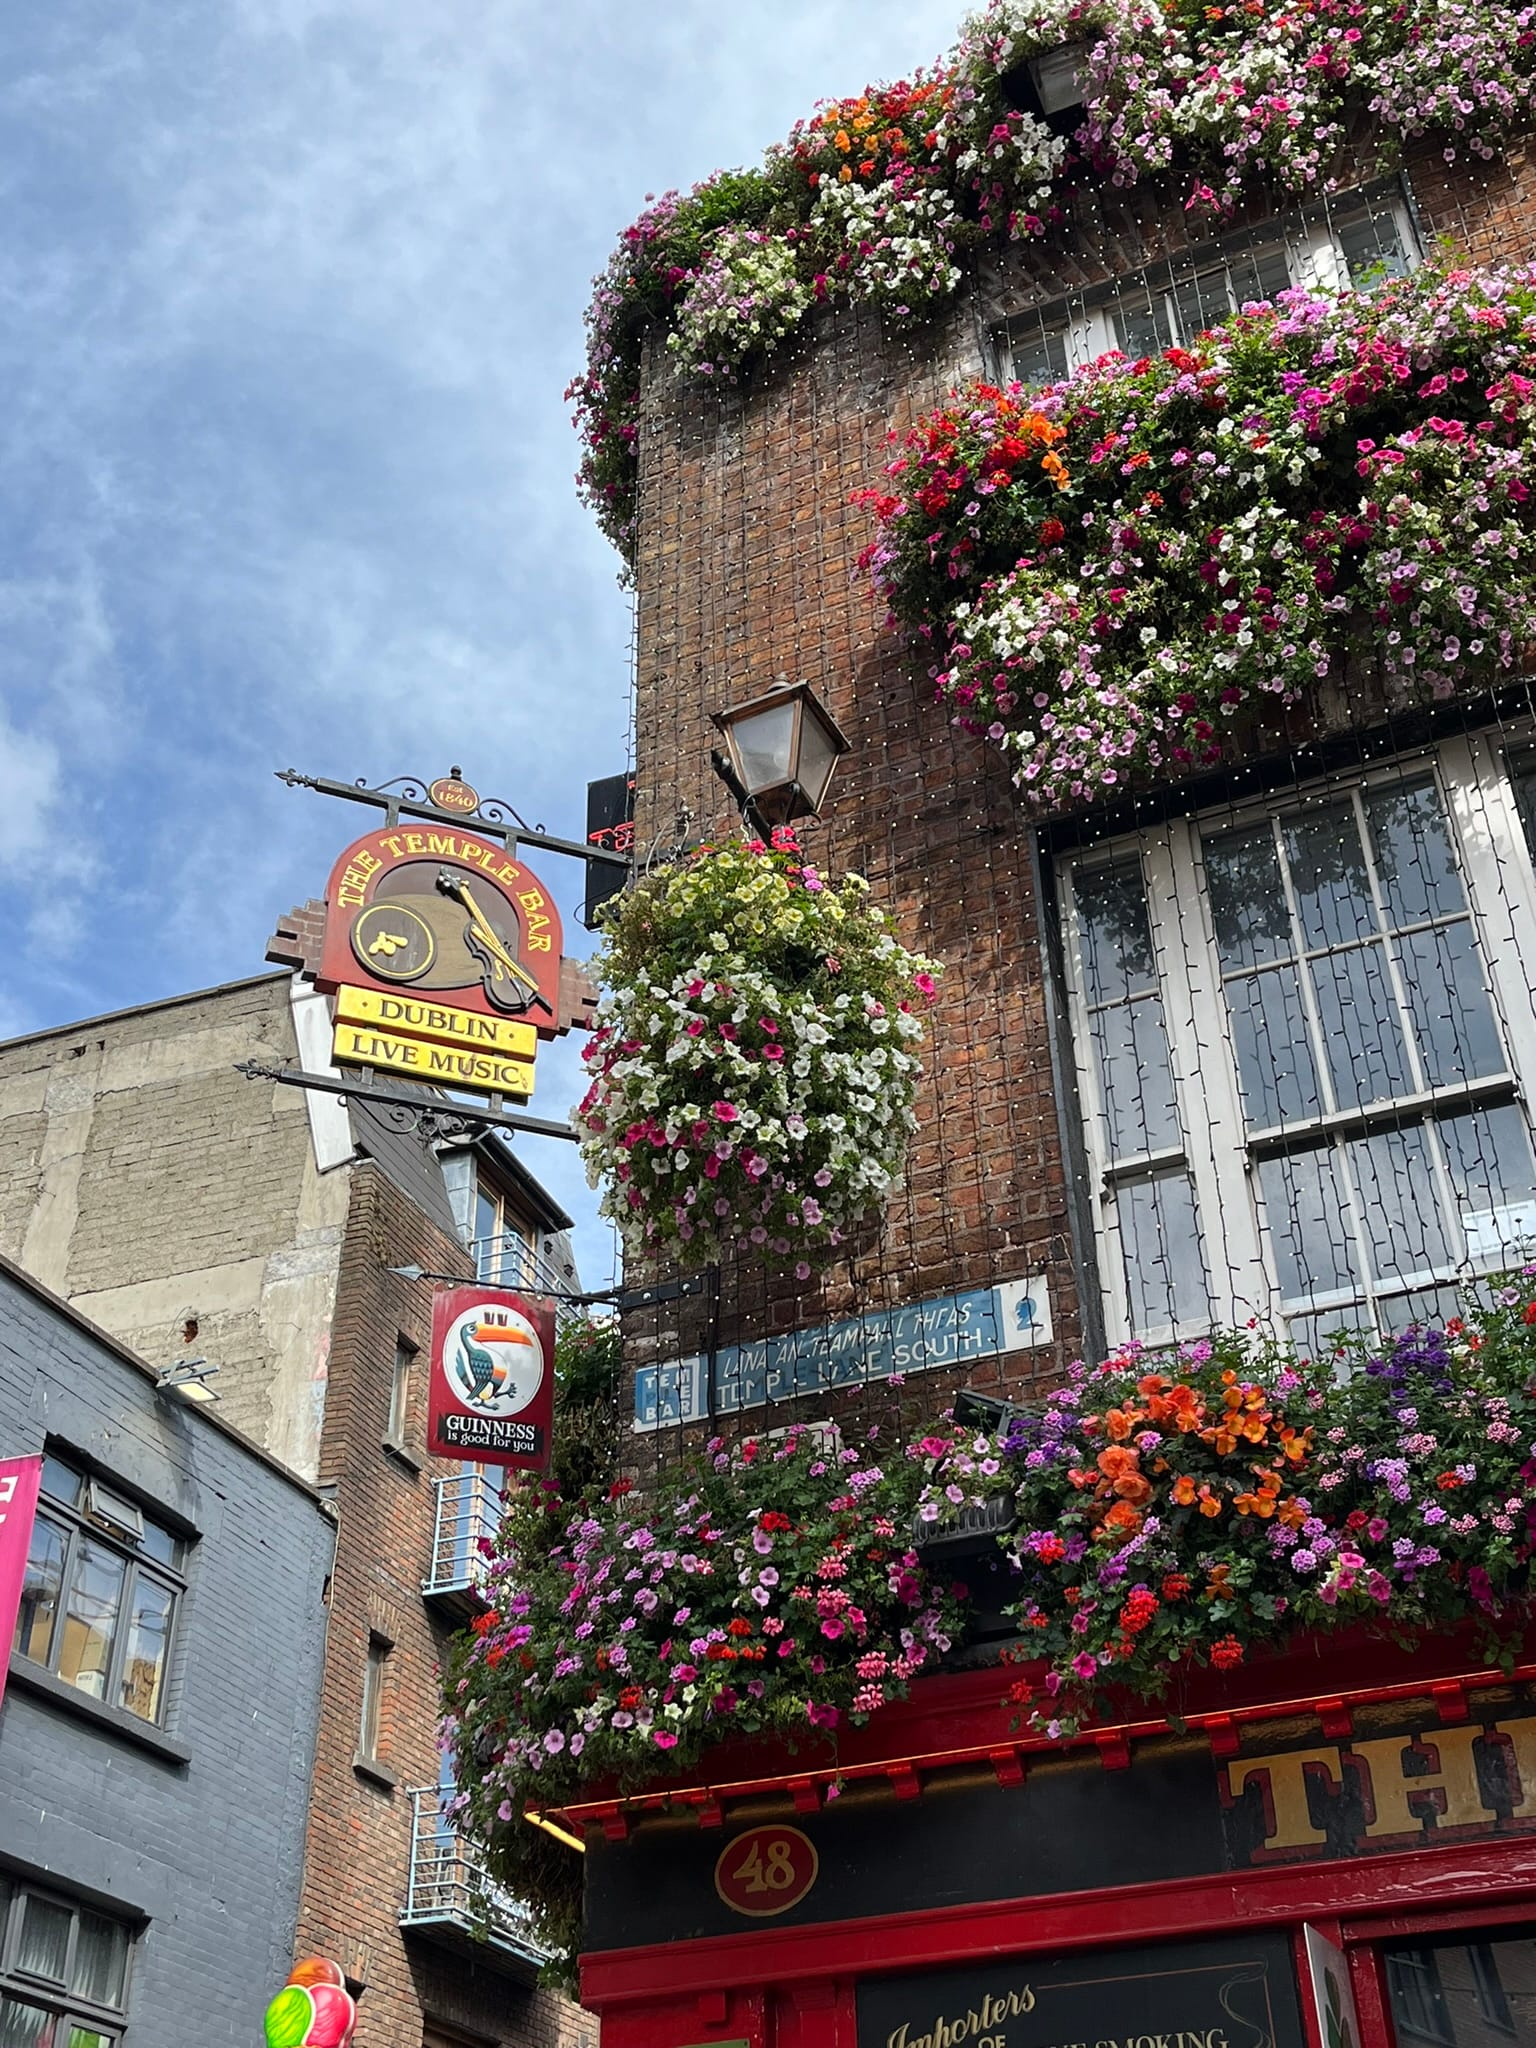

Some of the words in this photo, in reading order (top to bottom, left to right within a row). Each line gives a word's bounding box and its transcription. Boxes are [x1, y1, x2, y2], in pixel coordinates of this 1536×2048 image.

[439, 791, 474, 808] 1840
[337, 849, 383, 908] THE
[379, 832, 520, 887] TEMPLE
[515, 887, 552, 953] BAR
[378, 998, 500, 1041] DUBLIN
[352, 1033, 419, 1065] LIVE
[429, 1050, 520, 1085] MUSIC
[1015, 1297, 1037, 1331] 2
[776, 1340, 803, 1365] AN
[893, 1327, 982, 1366] SOUTH
[645, 1400, 690, 1420] BAR
[446, 1415, 535, 1440] GUINNESS
[447, 1430, 458, 1441] is
[460, 1432, 490, 1446] good
[493, 1434, 511, 1448] for
[513, 1440, 535, 1453] you
[733, 1840, 795, 1894] 48
